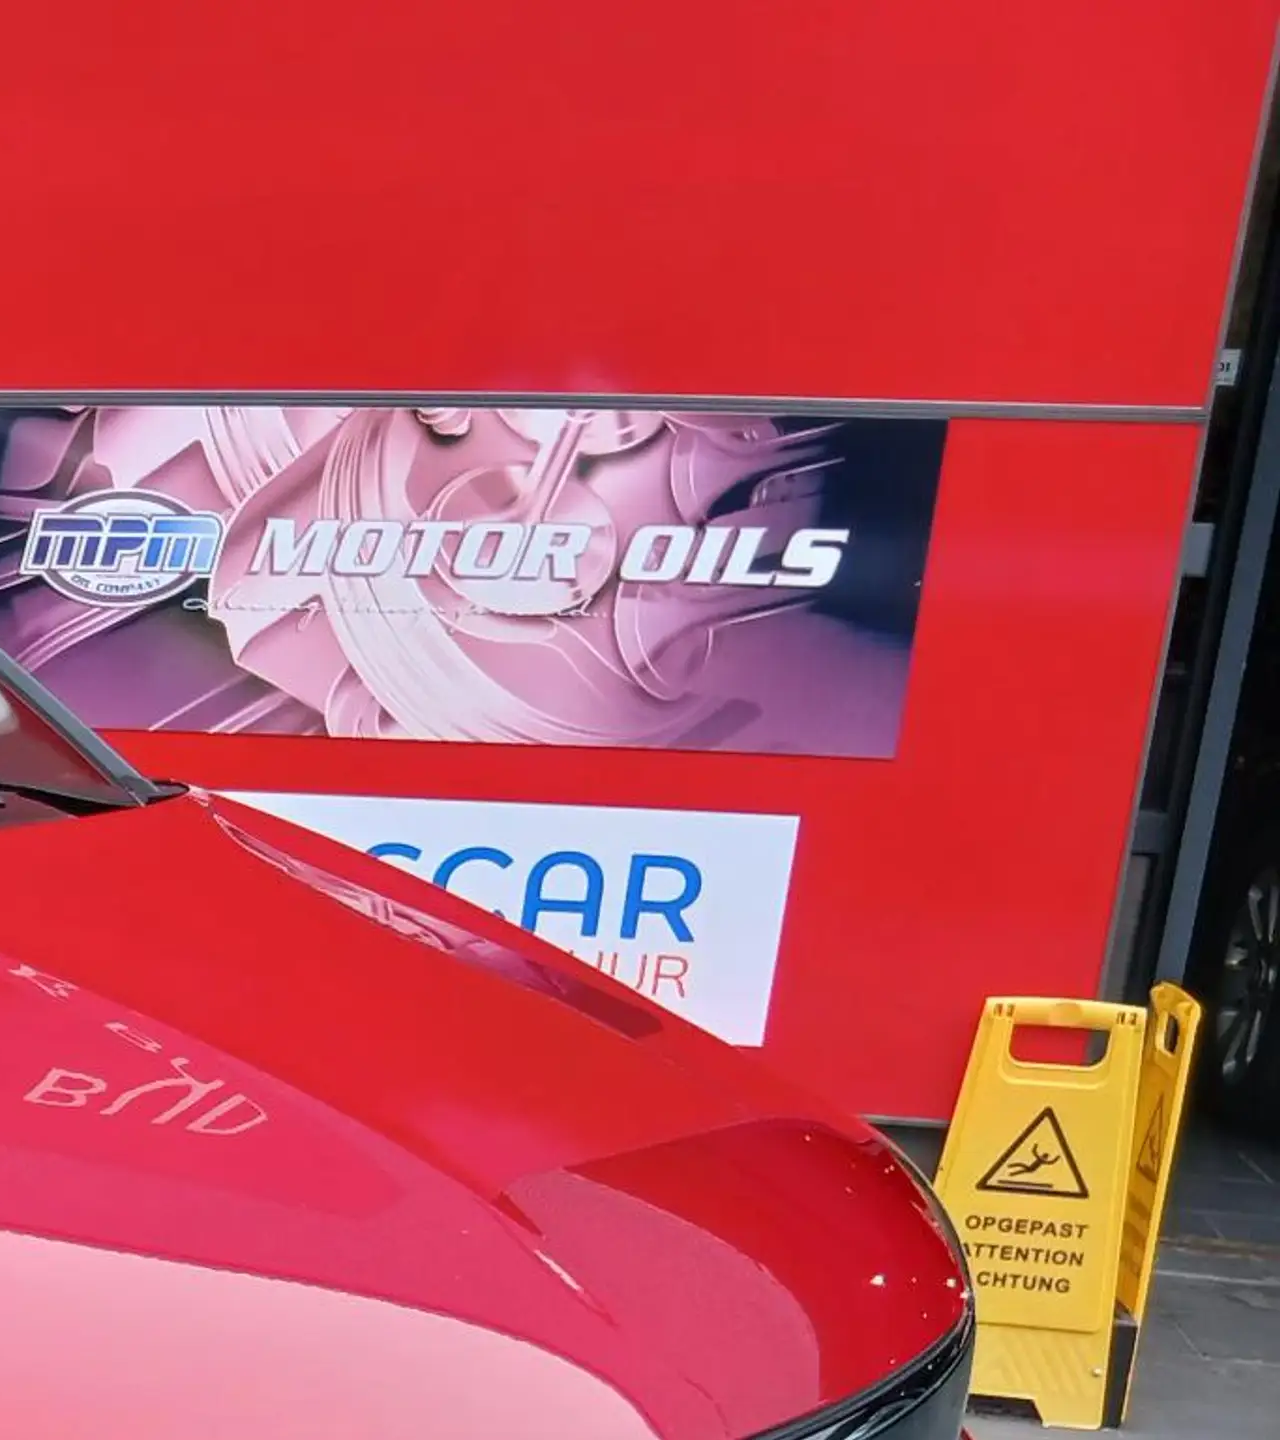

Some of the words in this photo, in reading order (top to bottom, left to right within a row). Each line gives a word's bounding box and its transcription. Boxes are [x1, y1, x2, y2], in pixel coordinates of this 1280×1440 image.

[251, 516, 590, 582] MOTOR
[618, 523, 850, 588] OILS
[366, 842, 703, 943] CAR
[964, 1214, 1090, 1239] OPGEPAST
